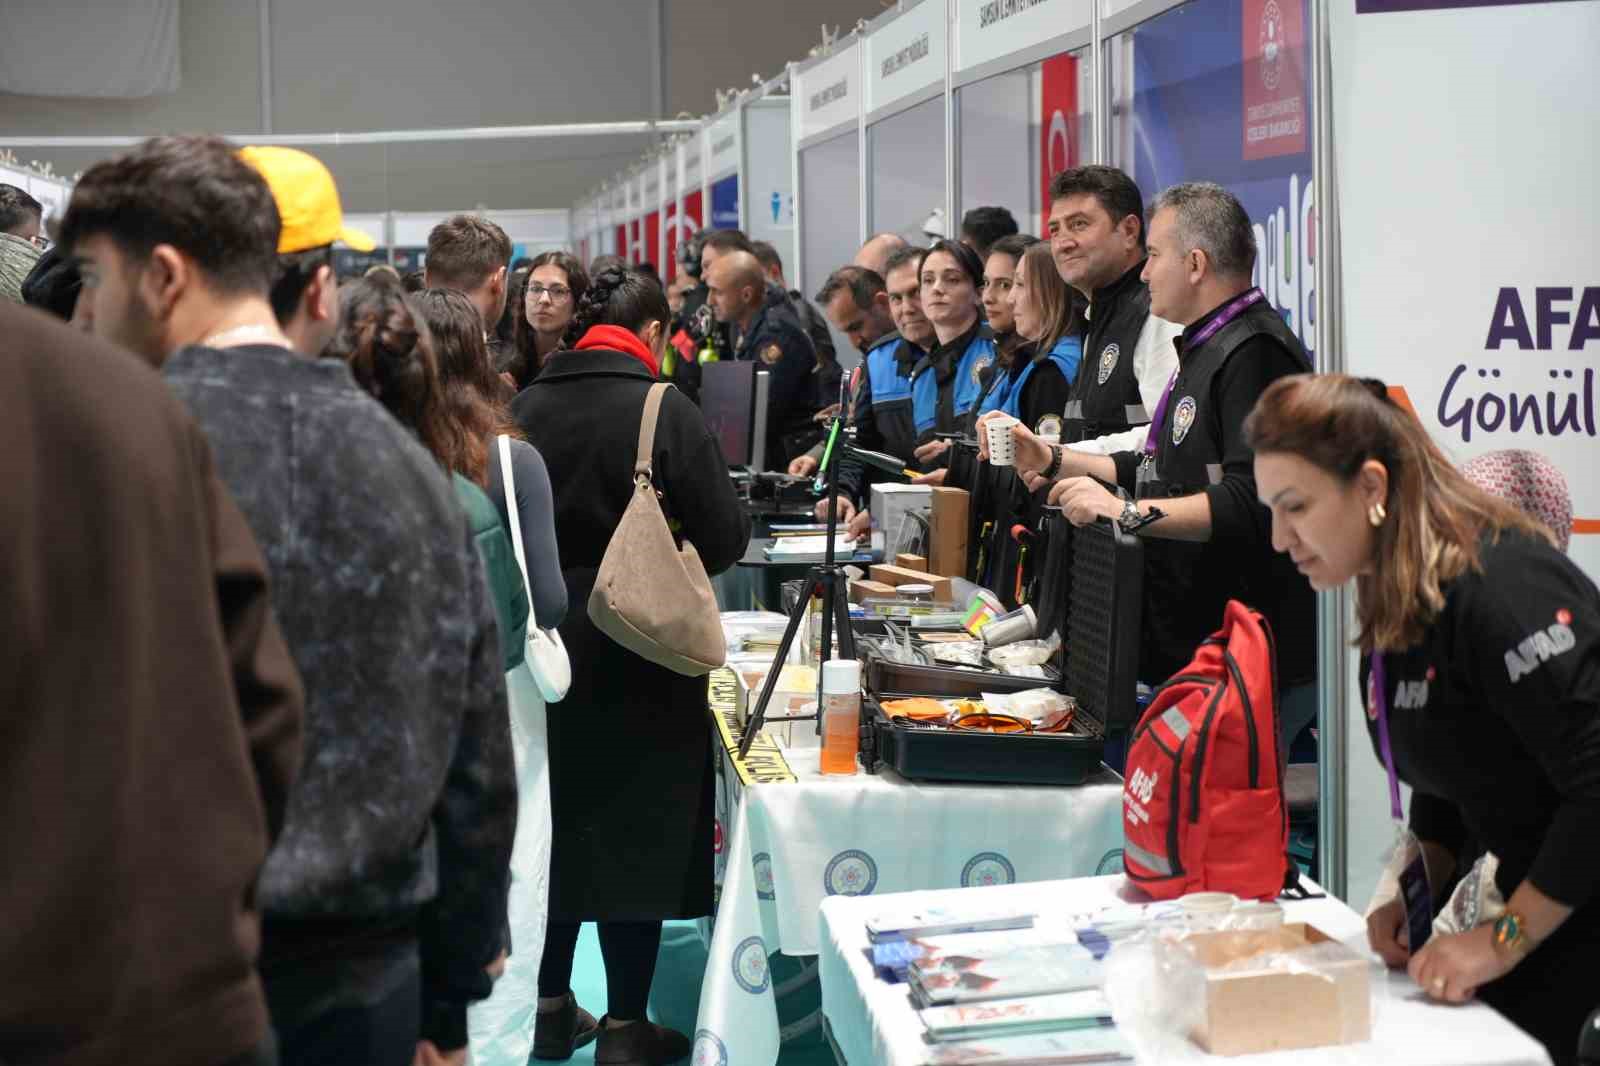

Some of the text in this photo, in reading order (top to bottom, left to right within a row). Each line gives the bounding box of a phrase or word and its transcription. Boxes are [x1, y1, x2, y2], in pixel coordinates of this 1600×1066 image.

[1484, 286, 1600, 351] AFA
[1437, 363, 1597, 443] Gönül
[1504, 622, 1577, 684] AFAD
